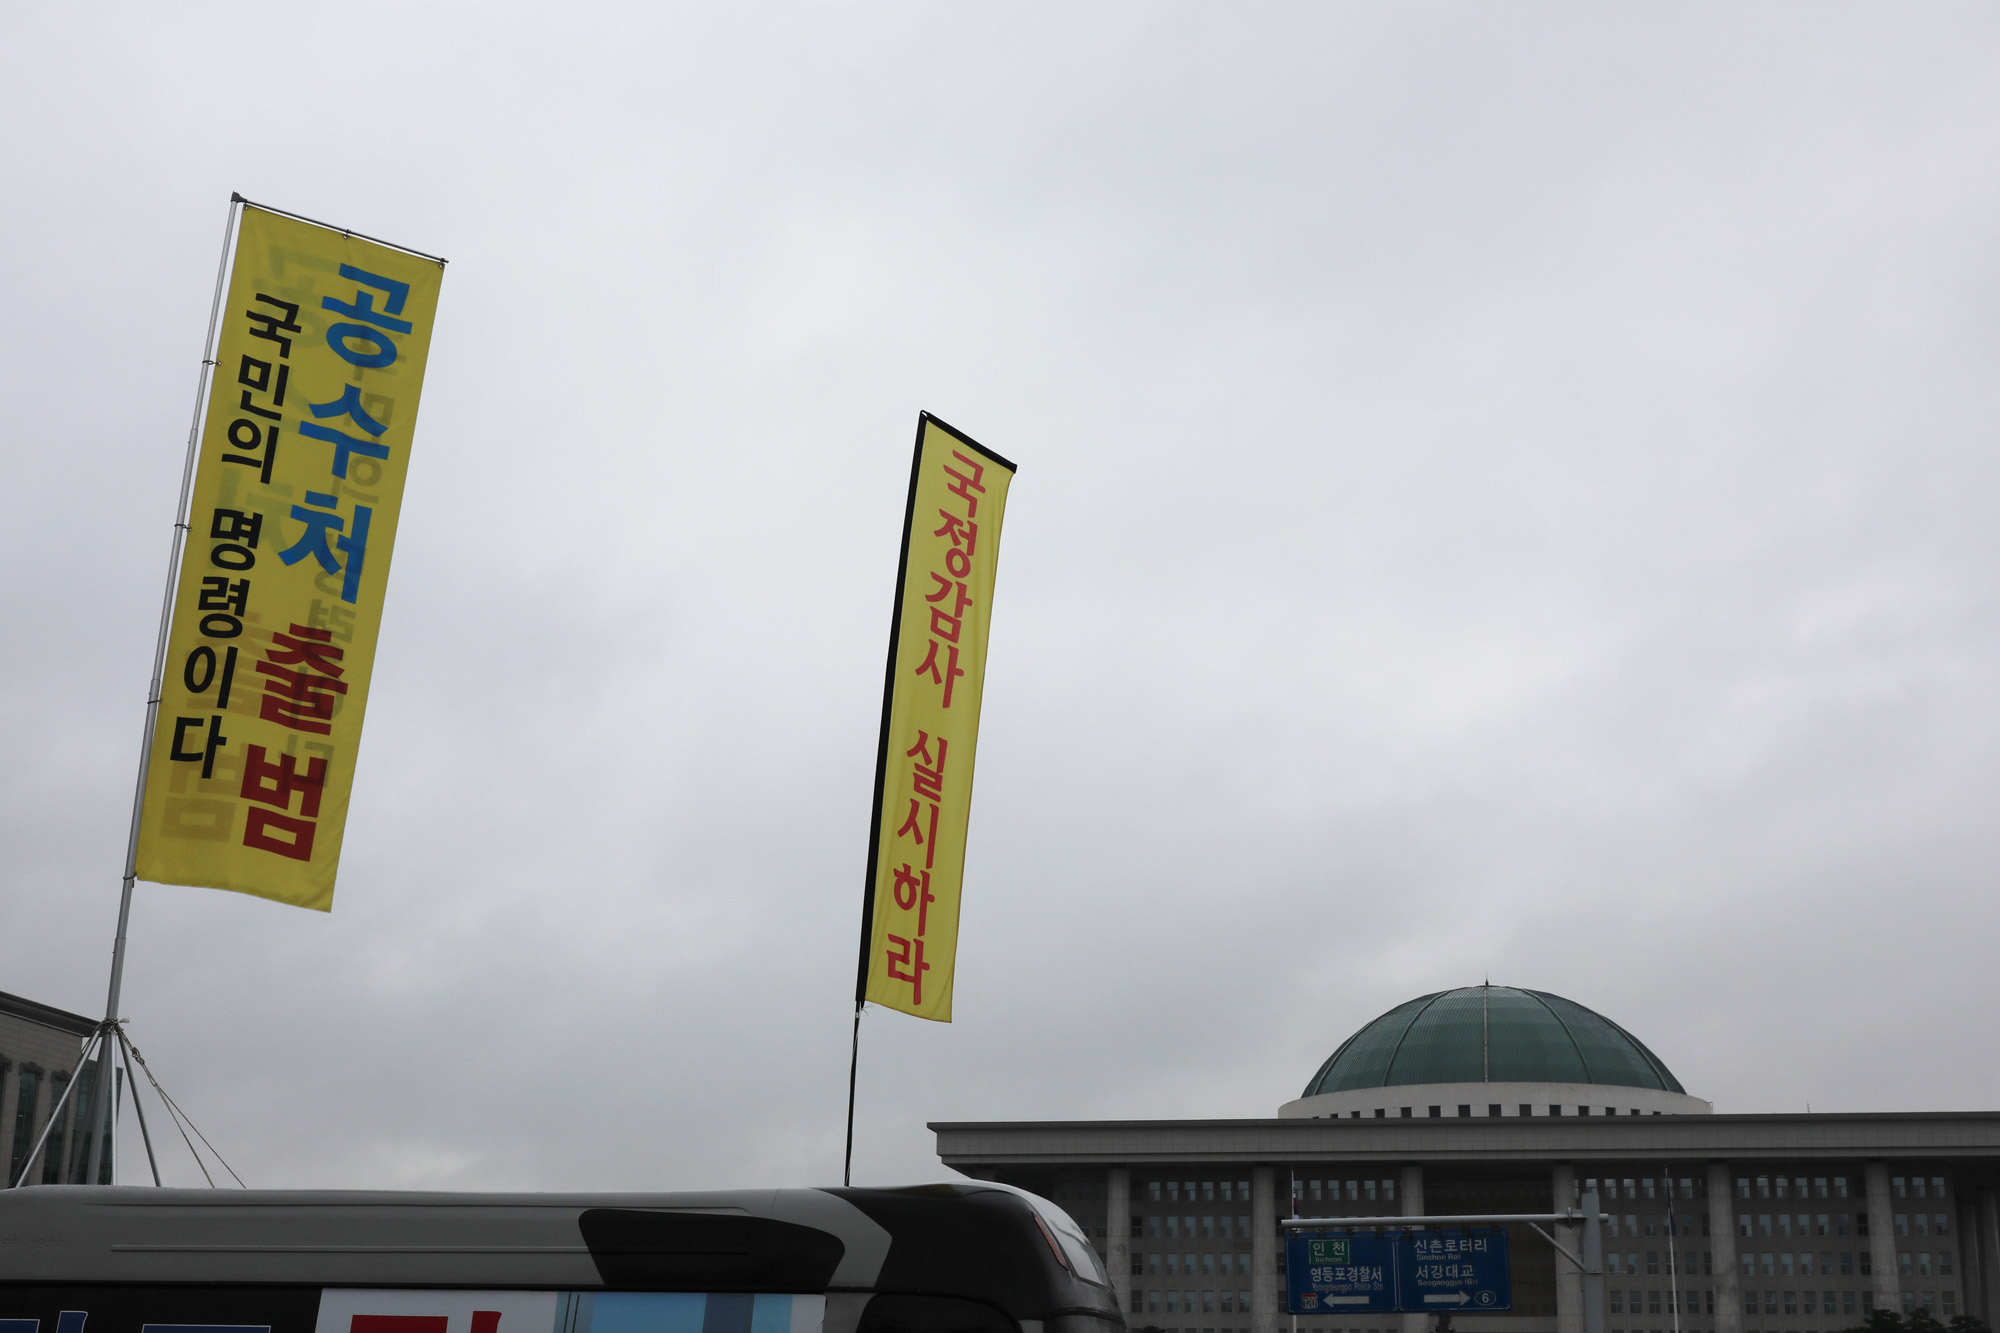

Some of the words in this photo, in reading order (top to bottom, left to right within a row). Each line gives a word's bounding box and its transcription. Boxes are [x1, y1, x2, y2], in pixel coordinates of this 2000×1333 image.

[221, 292, 302, 485] 국민의
[278, 263, 413, 604] 공수처
[915, 449, 986, 709] 국정감사
[169, 508, 264, 780] 명령이다
[240, 622, 349, 862] 출범
[886, 729, 948, 1006] 실시하라
[1310, 1266, 1382, 1282] 영등포경찰서
[1354, 1281, 1372, 1291] Police
[1373, 1281, 1384, 1291] Stn
[1414, 1238, 1487, 1253] 신촌로터리
[1415, 1264, 1474, 1279] 서강대교
[1417, 1279, 1463, 1288] Seoganggyo
[1481, 1292, 1490, 1303] 6
